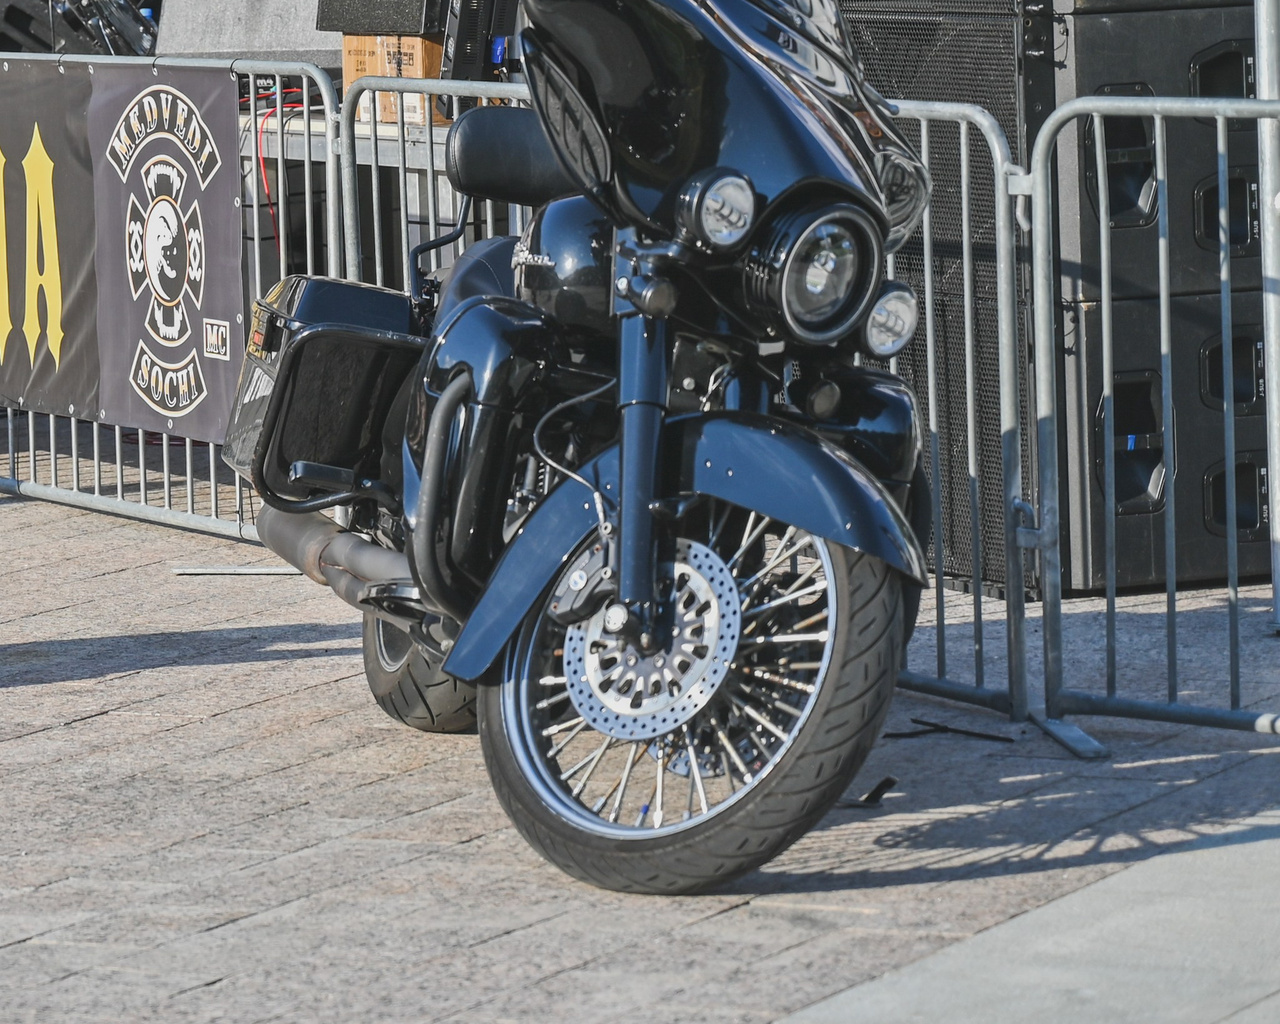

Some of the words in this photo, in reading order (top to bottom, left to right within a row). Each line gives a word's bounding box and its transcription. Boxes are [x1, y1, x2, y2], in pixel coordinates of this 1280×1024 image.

[111, 92, 213, 173] MEDVEDI
[205, 323, 227, 355] MC
[137, 354, 198, 407] SOCHI
